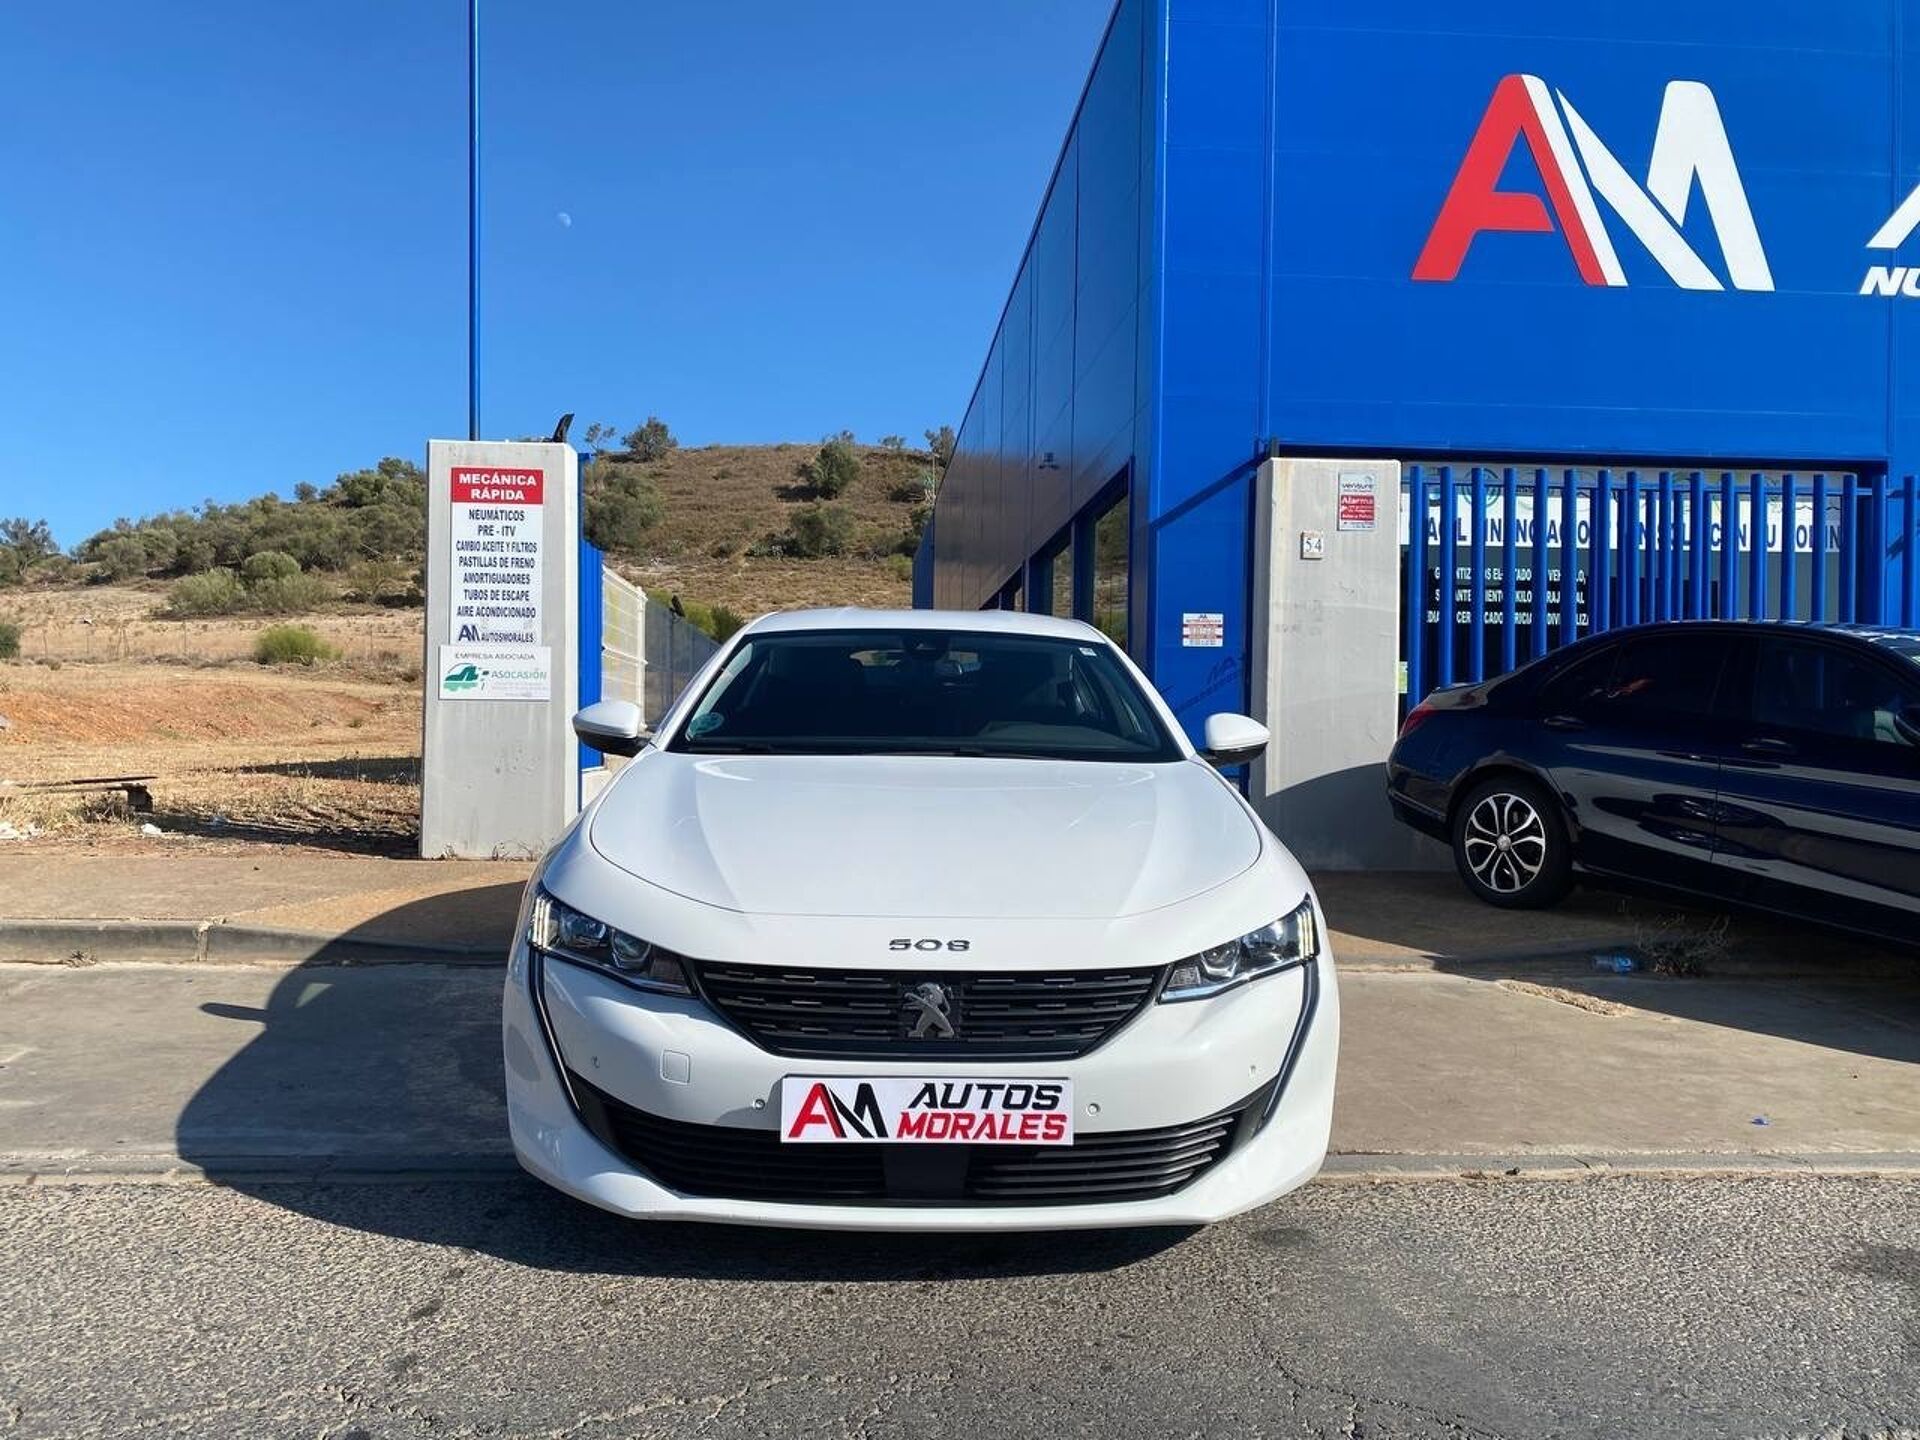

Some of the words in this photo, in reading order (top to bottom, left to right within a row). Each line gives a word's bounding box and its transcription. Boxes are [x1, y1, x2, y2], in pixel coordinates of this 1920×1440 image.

[459, 471, 537, 486] MECÁNICA
[470, 486, 525, 501] RÁPIDA
[478, 524, 494, 537] PRE
[501, 525, 516, 537] ITV
[456, 540, 481, 552] CAMBIO
[482, 541, 505, 553] ACEITE
[505, 541, 510, 553] Y
[511, 541, 538, 553] FILTROS
[459, 556, 498, 568] PASTILLAS
[499, 556, 509, 568] DE
[511, 557, 536, 569] FRENO
[463, 572, 530, 585] AMORTIGUADORES
[463, 589, 488, 601] TUBOS
[490, 589, 500, 601] DE
[501, 590, 530, 602] ESCAPE
[457, 605, 474, 617] AIRE
[475, 606, 537, 619] ACONDICIONADO
[495, 653, 536, 661] ASOCIADA
[889, 938, 970, 952] 508
[908, 1082, 1064, 1110] AUTOS
[897, 1111, 1068, 1141] MORALES
